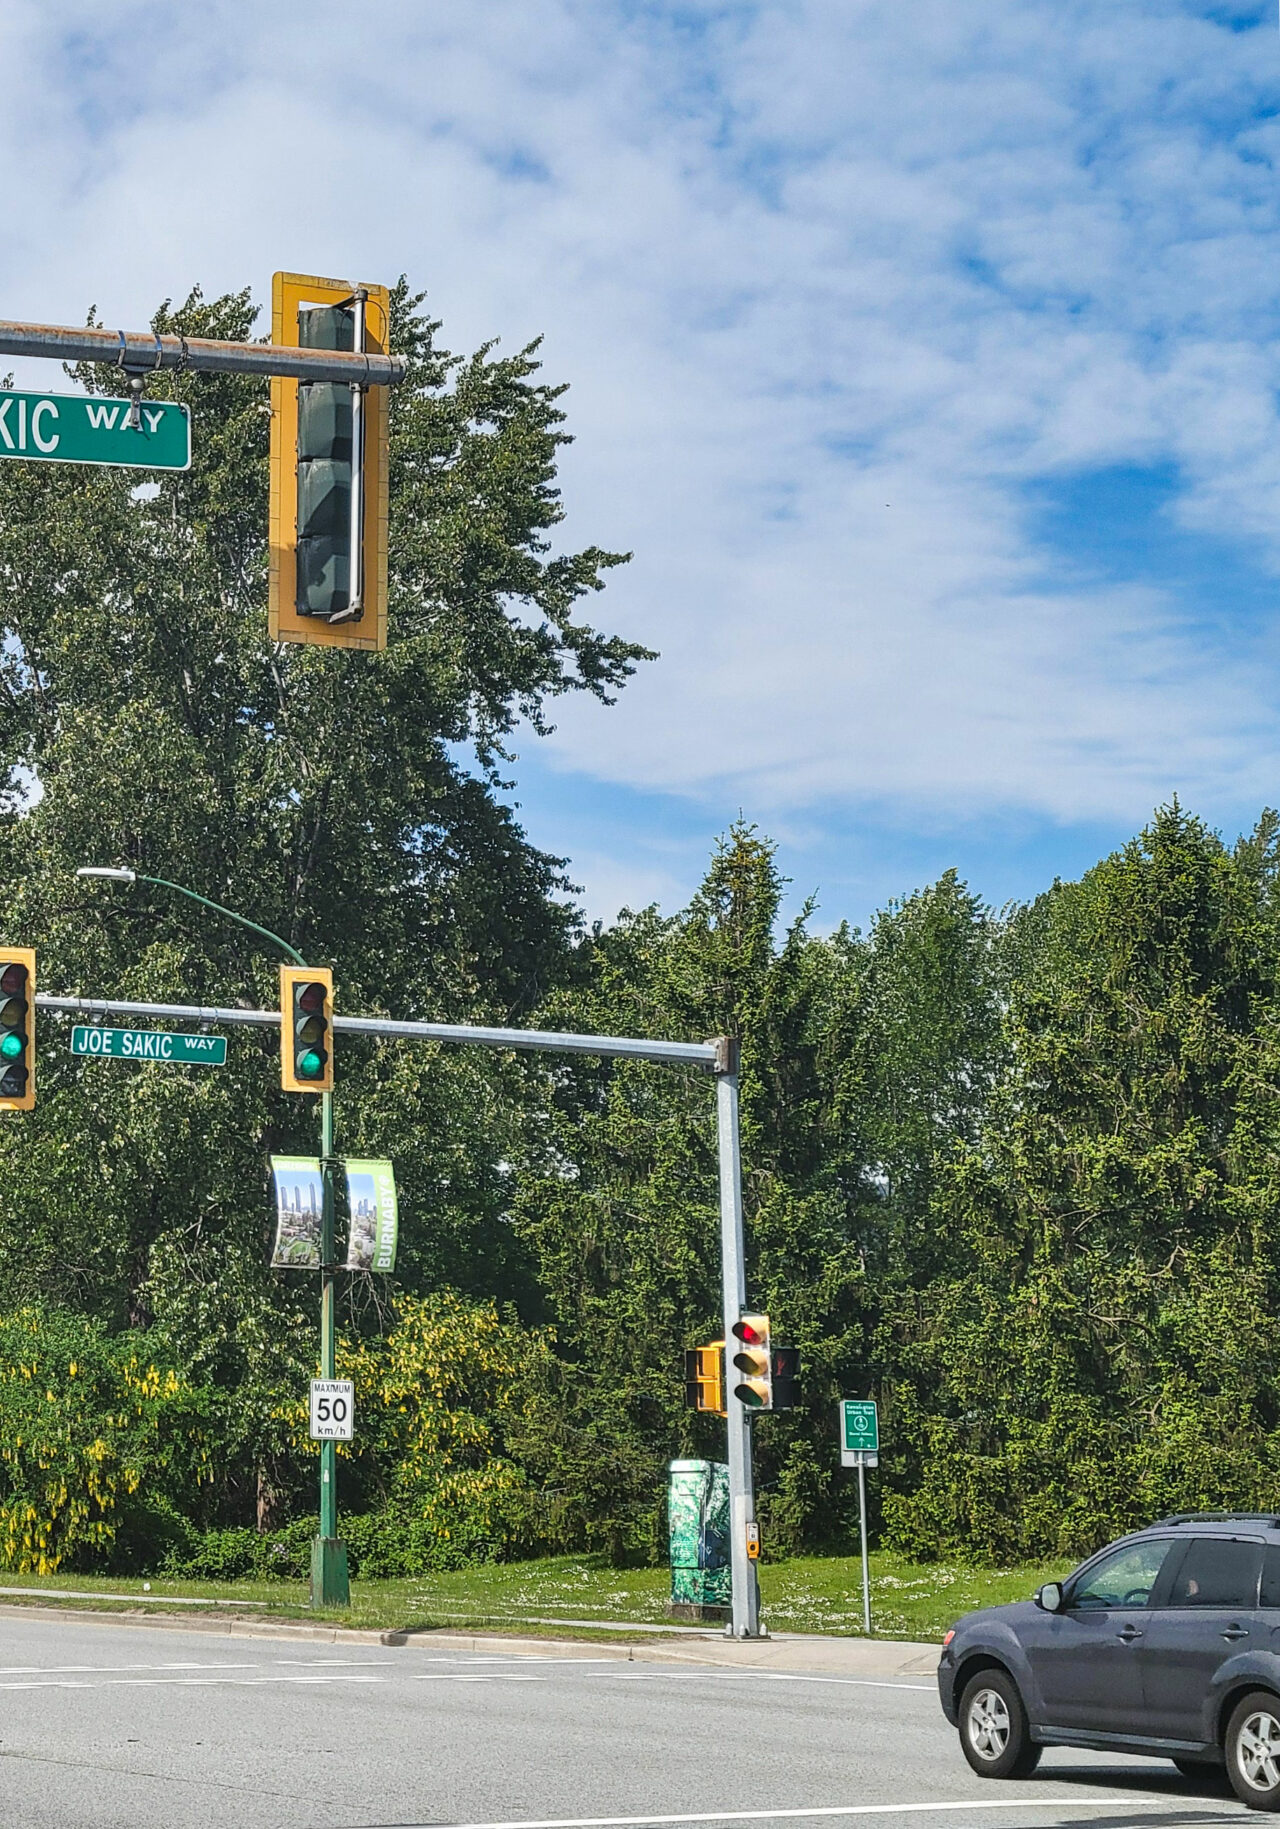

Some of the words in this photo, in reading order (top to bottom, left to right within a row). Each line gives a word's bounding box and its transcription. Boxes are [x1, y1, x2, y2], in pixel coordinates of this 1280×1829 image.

[78, 1030, 113, 1054] JOE
[121, 1032, 173, 1058] SAKIC
[184, 1037, 216, 1050] WAY
[376, 1188, 395, 1268] BURNABY
[314, 1383, 351, 1394] MAXIMUM
[317, 1397, 347, 1422] 50
[317, 1425, 346, 1436] km/h
